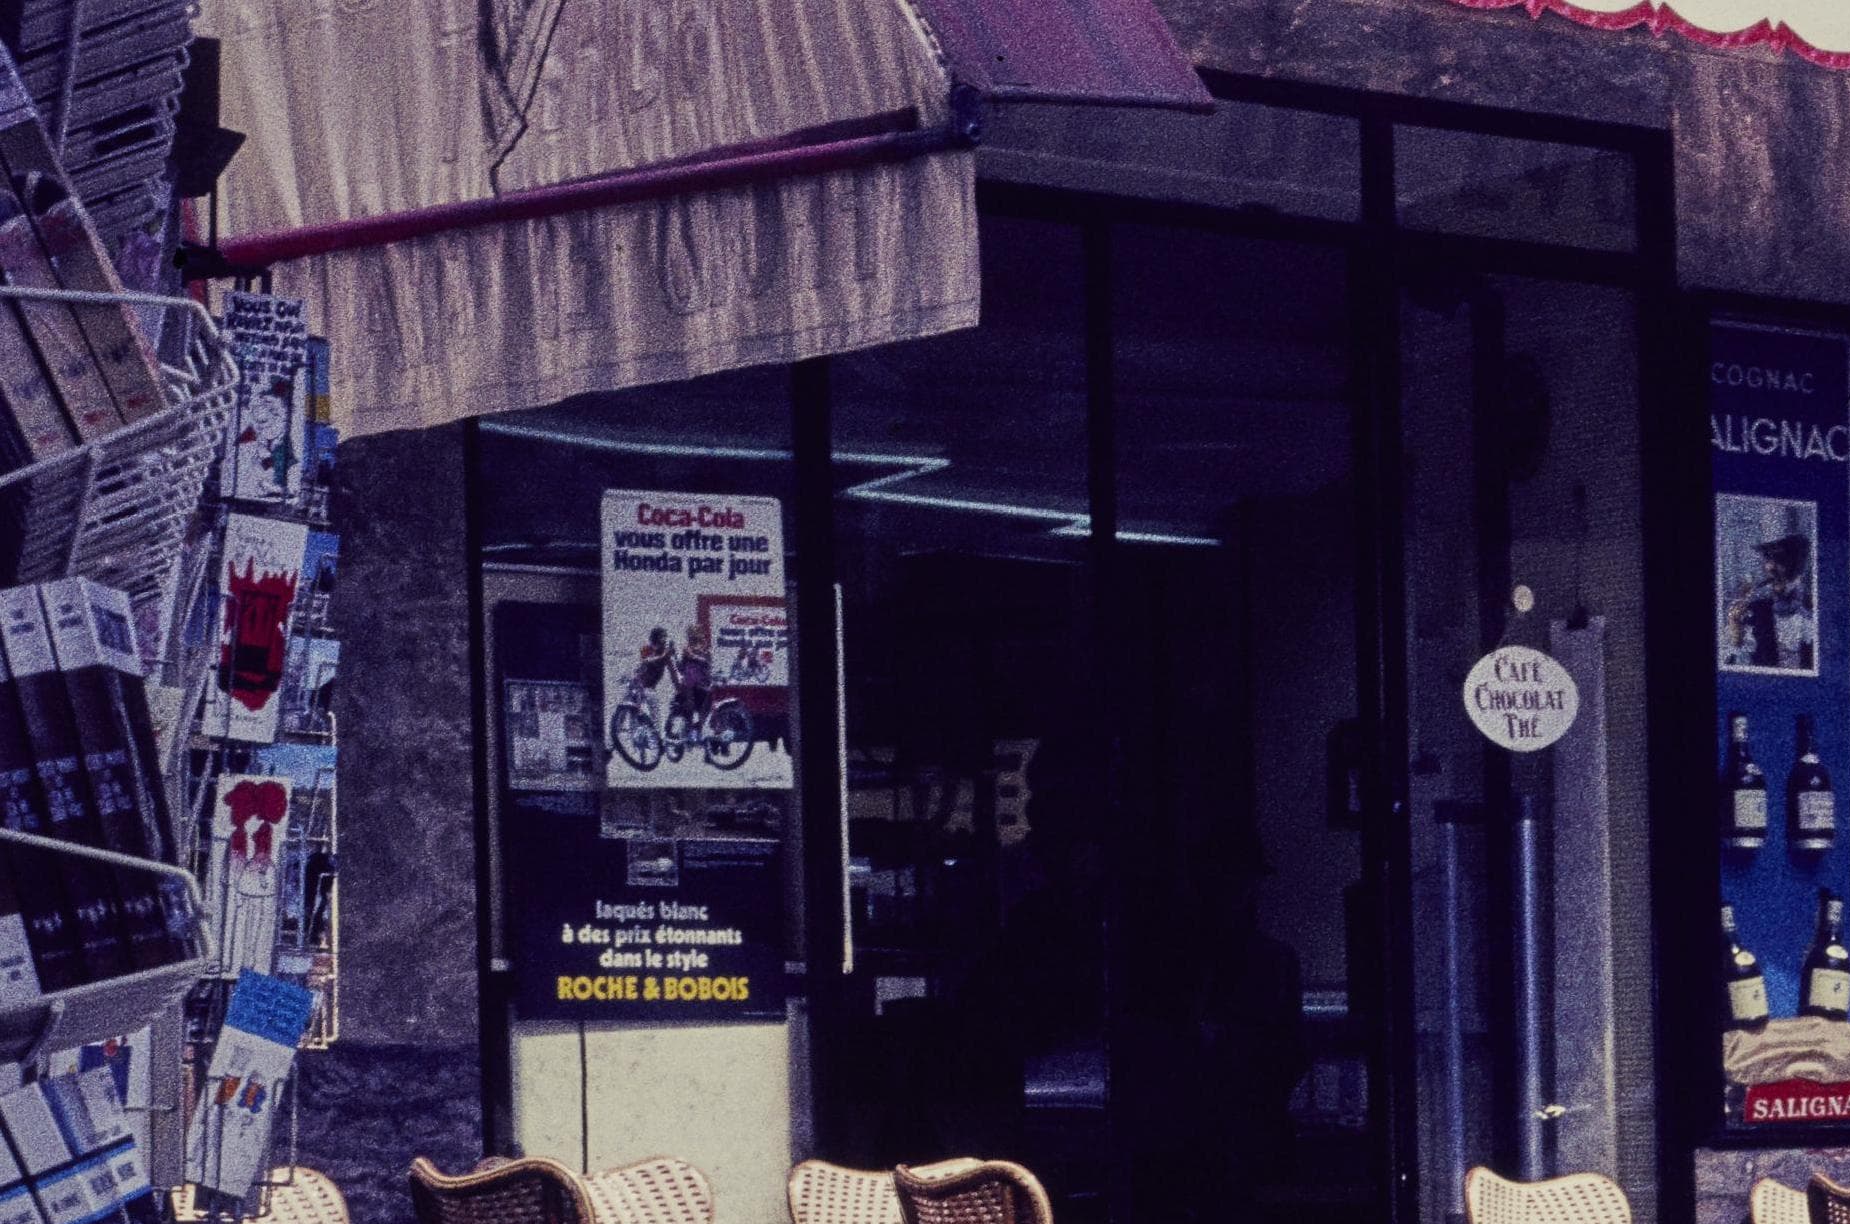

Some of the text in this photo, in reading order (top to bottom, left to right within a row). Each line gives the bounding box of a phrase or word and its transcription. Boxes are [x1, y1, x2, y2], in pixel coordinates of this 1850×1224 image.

[1711, 362, 1816, 394] COGNAC
[1710, 413, 1850, 462] ALIGNAC
[638, 503, 745, 530] Coca-Cola
[613, 529, 769, 552] vous offre une
[613, 549, 771, 580] Honda par jour
[1474, 682, 1566, 711] CHOCOLAT
[596, 899, 709, 923] laqués blanc
[561, 922, 743, 948] à des prix étonnants
[599, 948, 709, 971] dans le style
[557, 975, 750, 1001] ROCHE & BOBOIS
